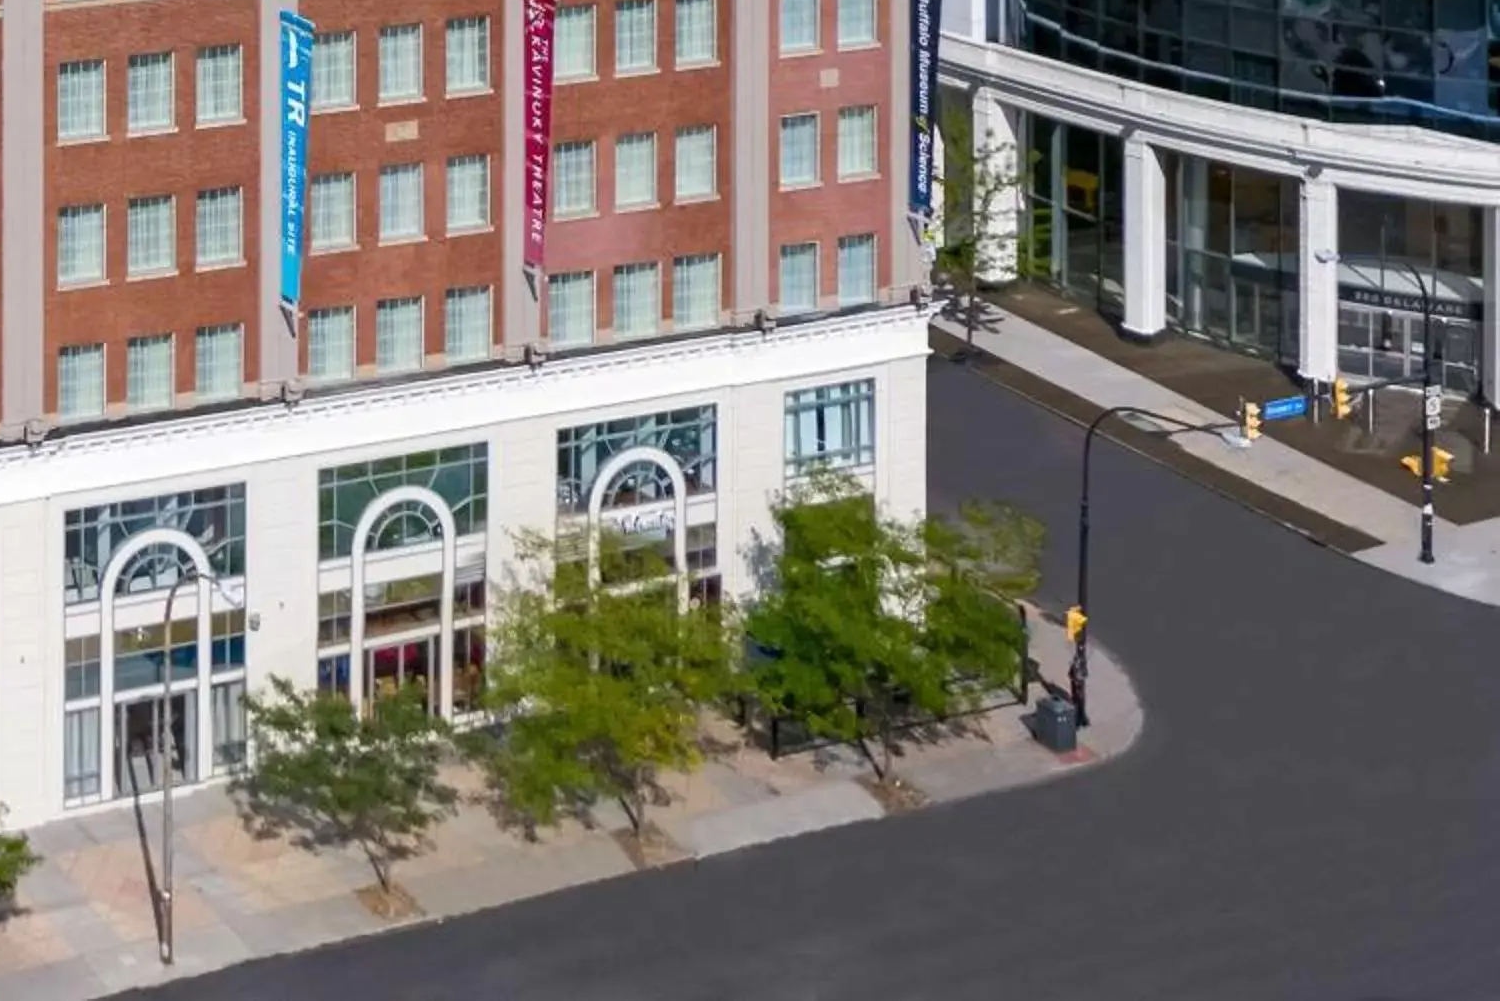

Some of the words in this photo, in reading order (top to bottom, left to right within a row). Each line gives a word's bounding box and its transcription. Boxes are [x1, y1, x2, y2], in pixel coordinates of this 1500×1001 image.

[287, 79, 306, 128] TR
[918, 49, 930, 113] Museum
[917, 133, 930, 194] Science
[531, 154, 543, 243] THEATRE
